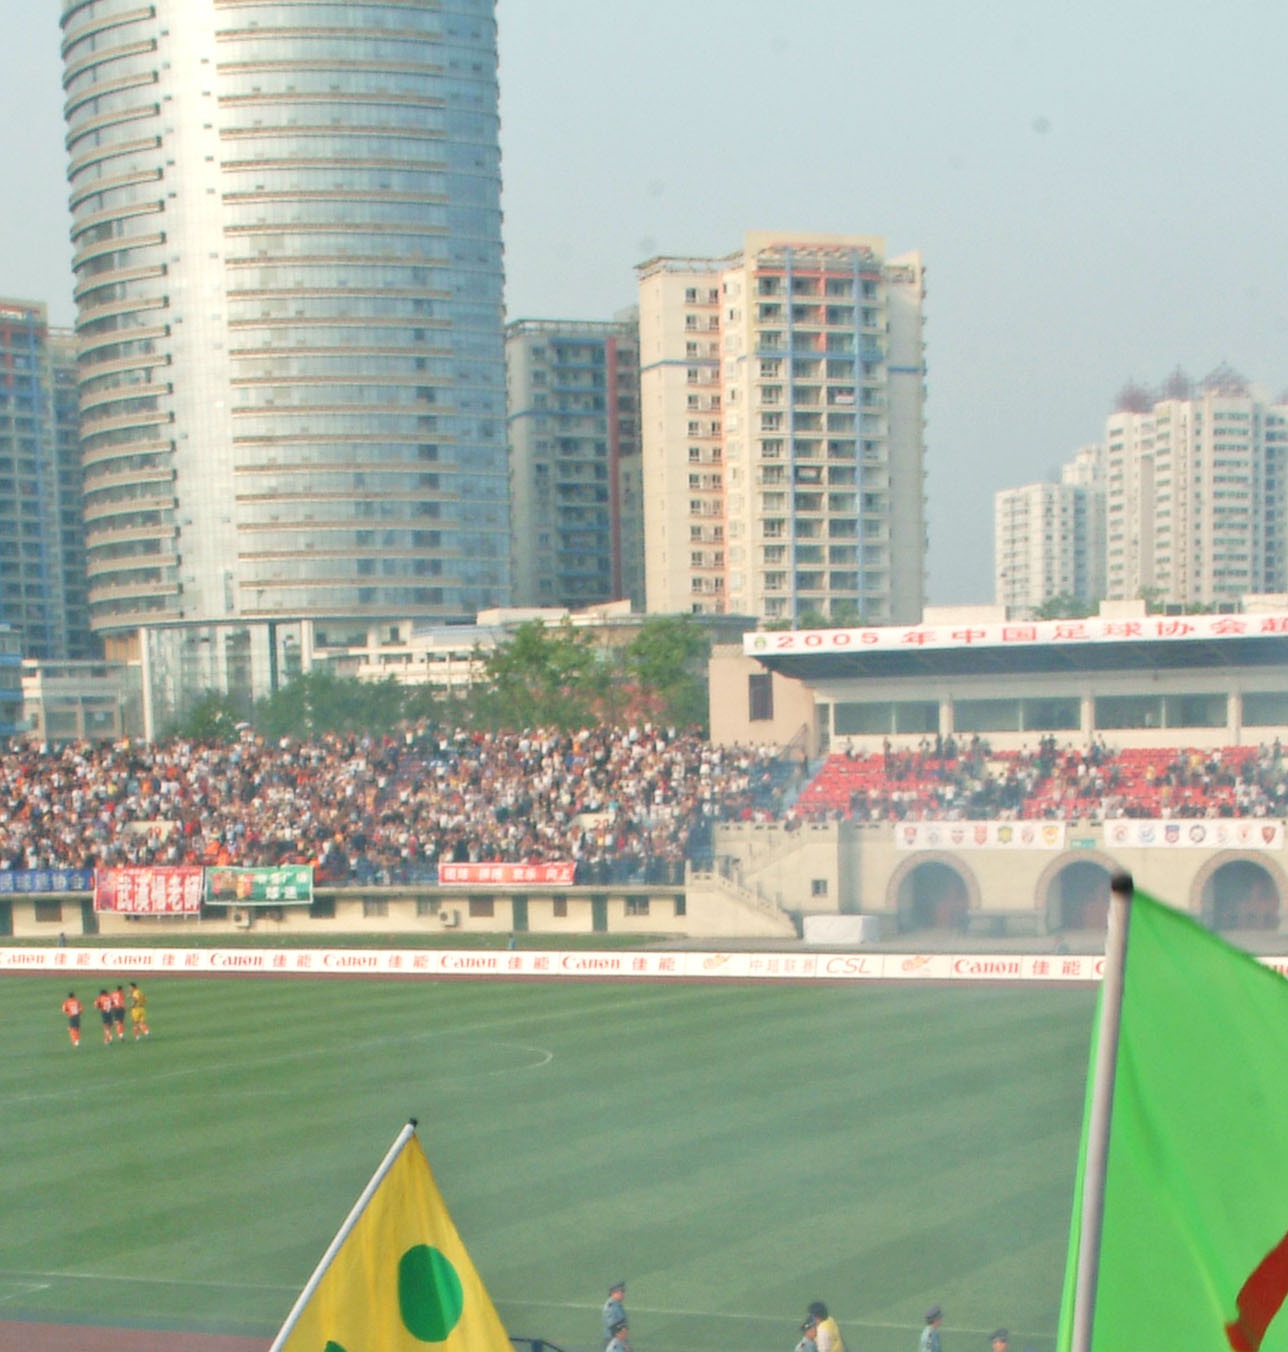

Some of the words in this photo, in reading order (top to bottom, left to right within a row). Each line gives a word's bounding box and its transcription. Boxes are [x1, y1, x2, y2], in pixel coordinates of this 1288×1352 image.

[54, 953, 90, 967] 佳能
[101, 952, 152, 966] Canon
[162, 953, 199, 967] 佳能
[210, 952, 263, 967] Canon
[272, 954, 312, 968] 佳能
[323, 953, 377, 967] Canon
[388, 954, 429, 969] 佳能
[440, 954, 497, 968] Canon
[508, 956, 549, 970] 佳能
[562, 955, 620, 970] Canon
[632, 956, 676, 972] 佳能
[825, 957, 872, 975] CSL
[953, 958, 1019, 974] Canon
[1031, 959, 1081, 976] 佳能
